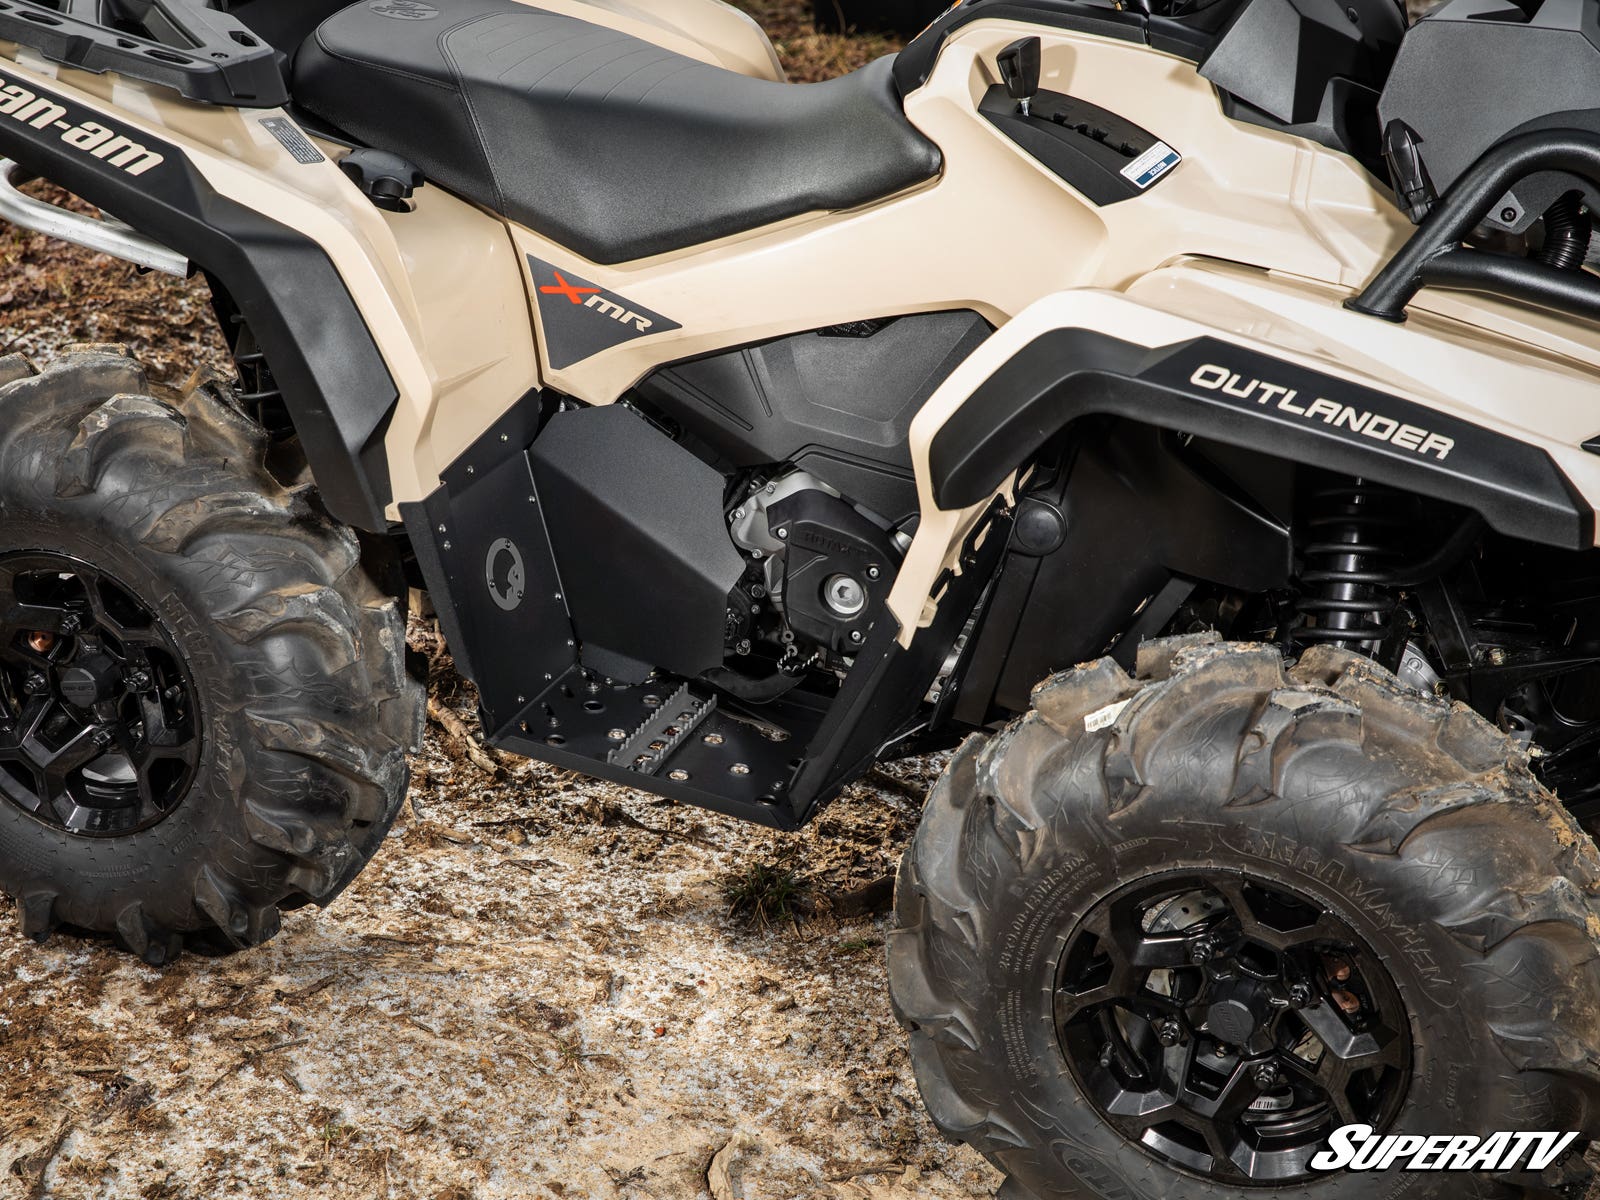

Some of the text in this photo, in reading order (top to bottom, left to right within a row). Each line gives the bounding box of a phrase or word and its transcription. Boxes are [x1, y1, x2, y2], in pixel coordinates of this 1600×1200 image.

[0, 78, 164, 176] an-am
[1190, 364, 1455, 460] OUTLANDER
[1346, 876, 1458, 987] MAYHEM
